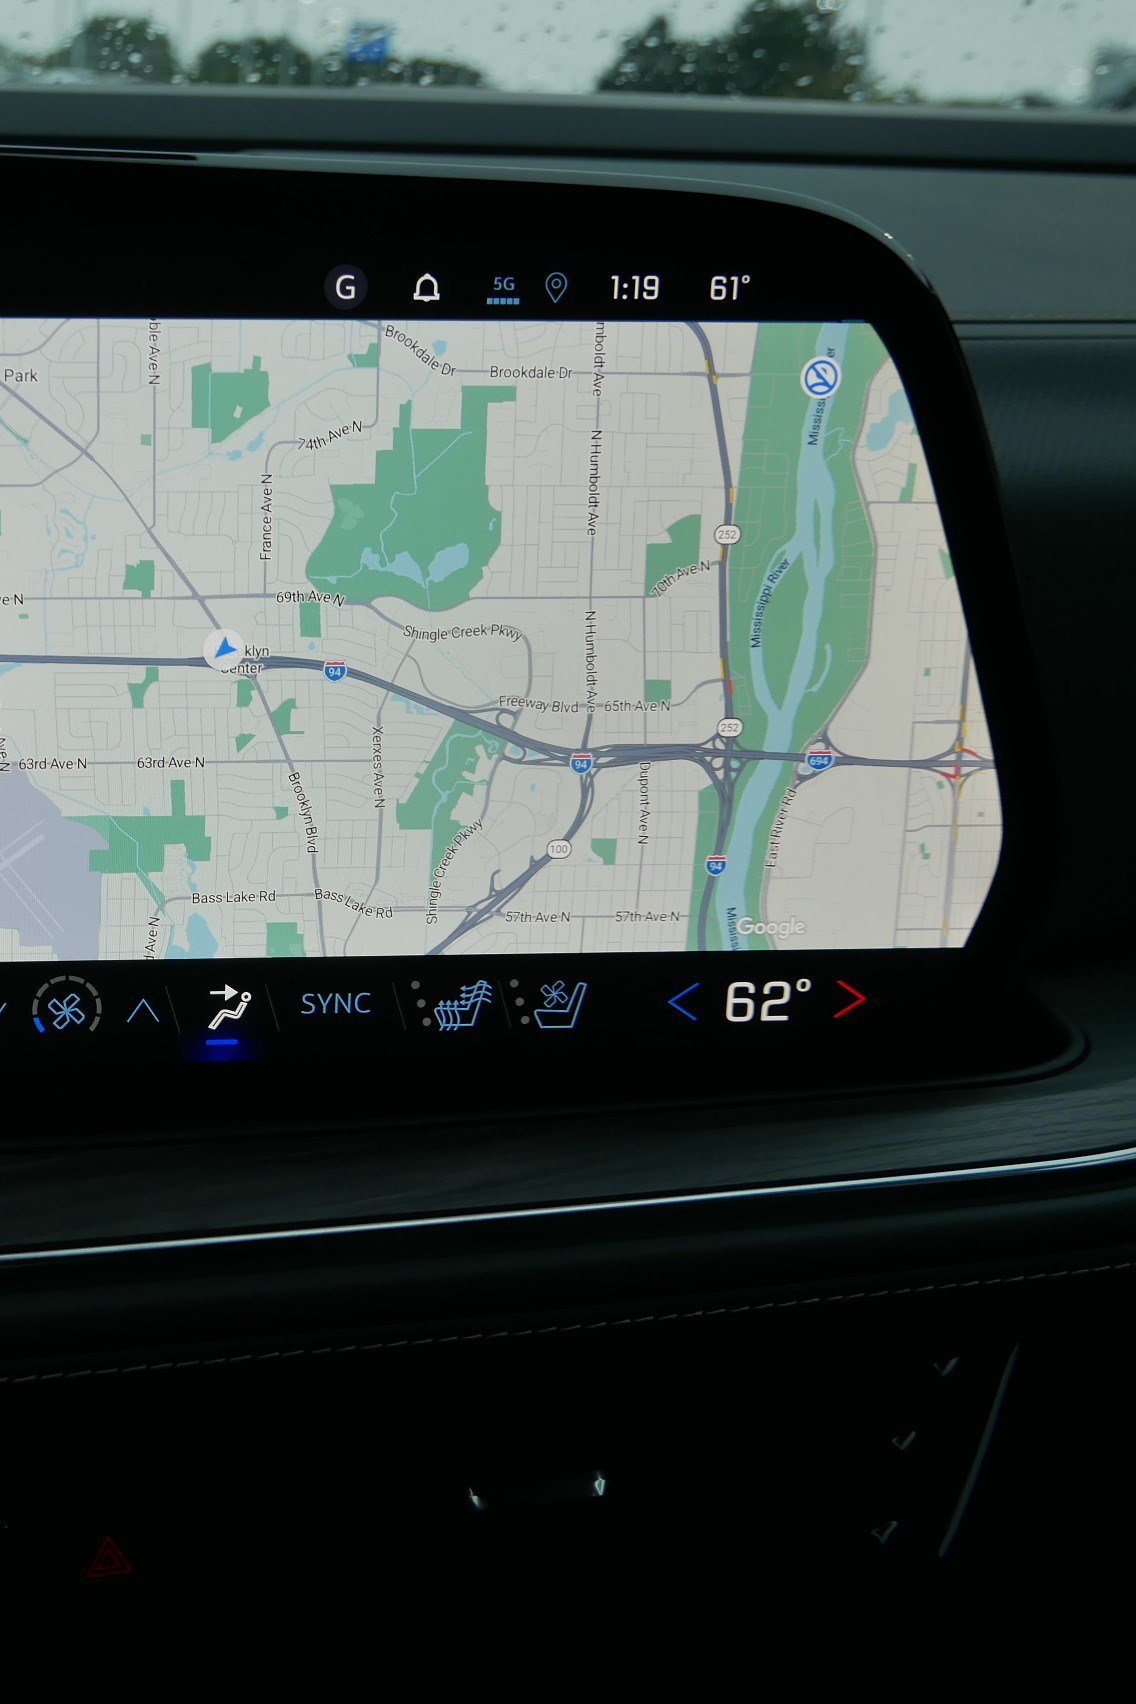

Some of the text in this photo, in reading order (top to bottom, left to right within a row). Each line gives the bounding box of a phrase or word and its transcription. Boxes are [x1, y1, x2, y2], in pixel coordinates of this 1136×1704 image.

[335, 275, 355, 300] G
[493, 277, 515, 291] 5G
[611, 275, 659, 300] 1:19
[149, 346, 160, 370] Ave
[384, 324, 456, 377] Brookdale Dr
[4, 369, 37, 383] Park
[149, 375, 160, 384] N
[490, 366, 573, 379] Brookdale Dr
[593, 373, 604, 396] Ave
[298, 421, 362, 450] 74th Ave N
[587, 430, 603, 536] N Humboldt Ave
[260, 474, 272, 560] France Ave N
[719, 530, 736, 540] 252
[651, 560, 710, 597] 70th Ave N
[14, 594, 24, 605] N
[275, 590, 346, 607] 69th Ave N
[750, 558, 791, 648] Mississippi River
[402, 624, 523, 643] Shingle Creek Pkwy
[221, 664, 263, 673] enter
[585, 611, 597, 713] N Humboldt Ave
[328, 667, 341, 677] 94
[499, 695, 579, 714] Freeway Blvd
[604, 700, 671, 713] 65th Ave N
[721, 723, 739, 734] 252
[18, 758, 87, 770] 63rd Ave N
[137, 757, 205, 769] 63rd Ave N
[372, 726, 385, 808] Xerxes Ave N
[574, 760, 588, 770] 94
[810, 756, 828, 767] 694
[288, 772, 318, 854] Brooklyn Blvd
[638, 762, 651, 845] Dupont Ave N
[766, 788, 797, 868] East River Rd
[550, 844, 568, 855] 100
[426, 818, 483, 925] Shingle Creek Pkwy
[709, 861, 722, 871] 94
[192, 891, 276, 904] Bass Lake Rd
[314, 888, 393, 919] Bass Lake Rd
[148, 917, 160, 926] N
[505, 912, 571, 924] 57th Ave N
[615, 911, 680, 923] 57th Ave N
[737, 915, 807, 939] Google
[145, 931, 157, 952] Ave
[300, 992, 371, 1015] SYNC
